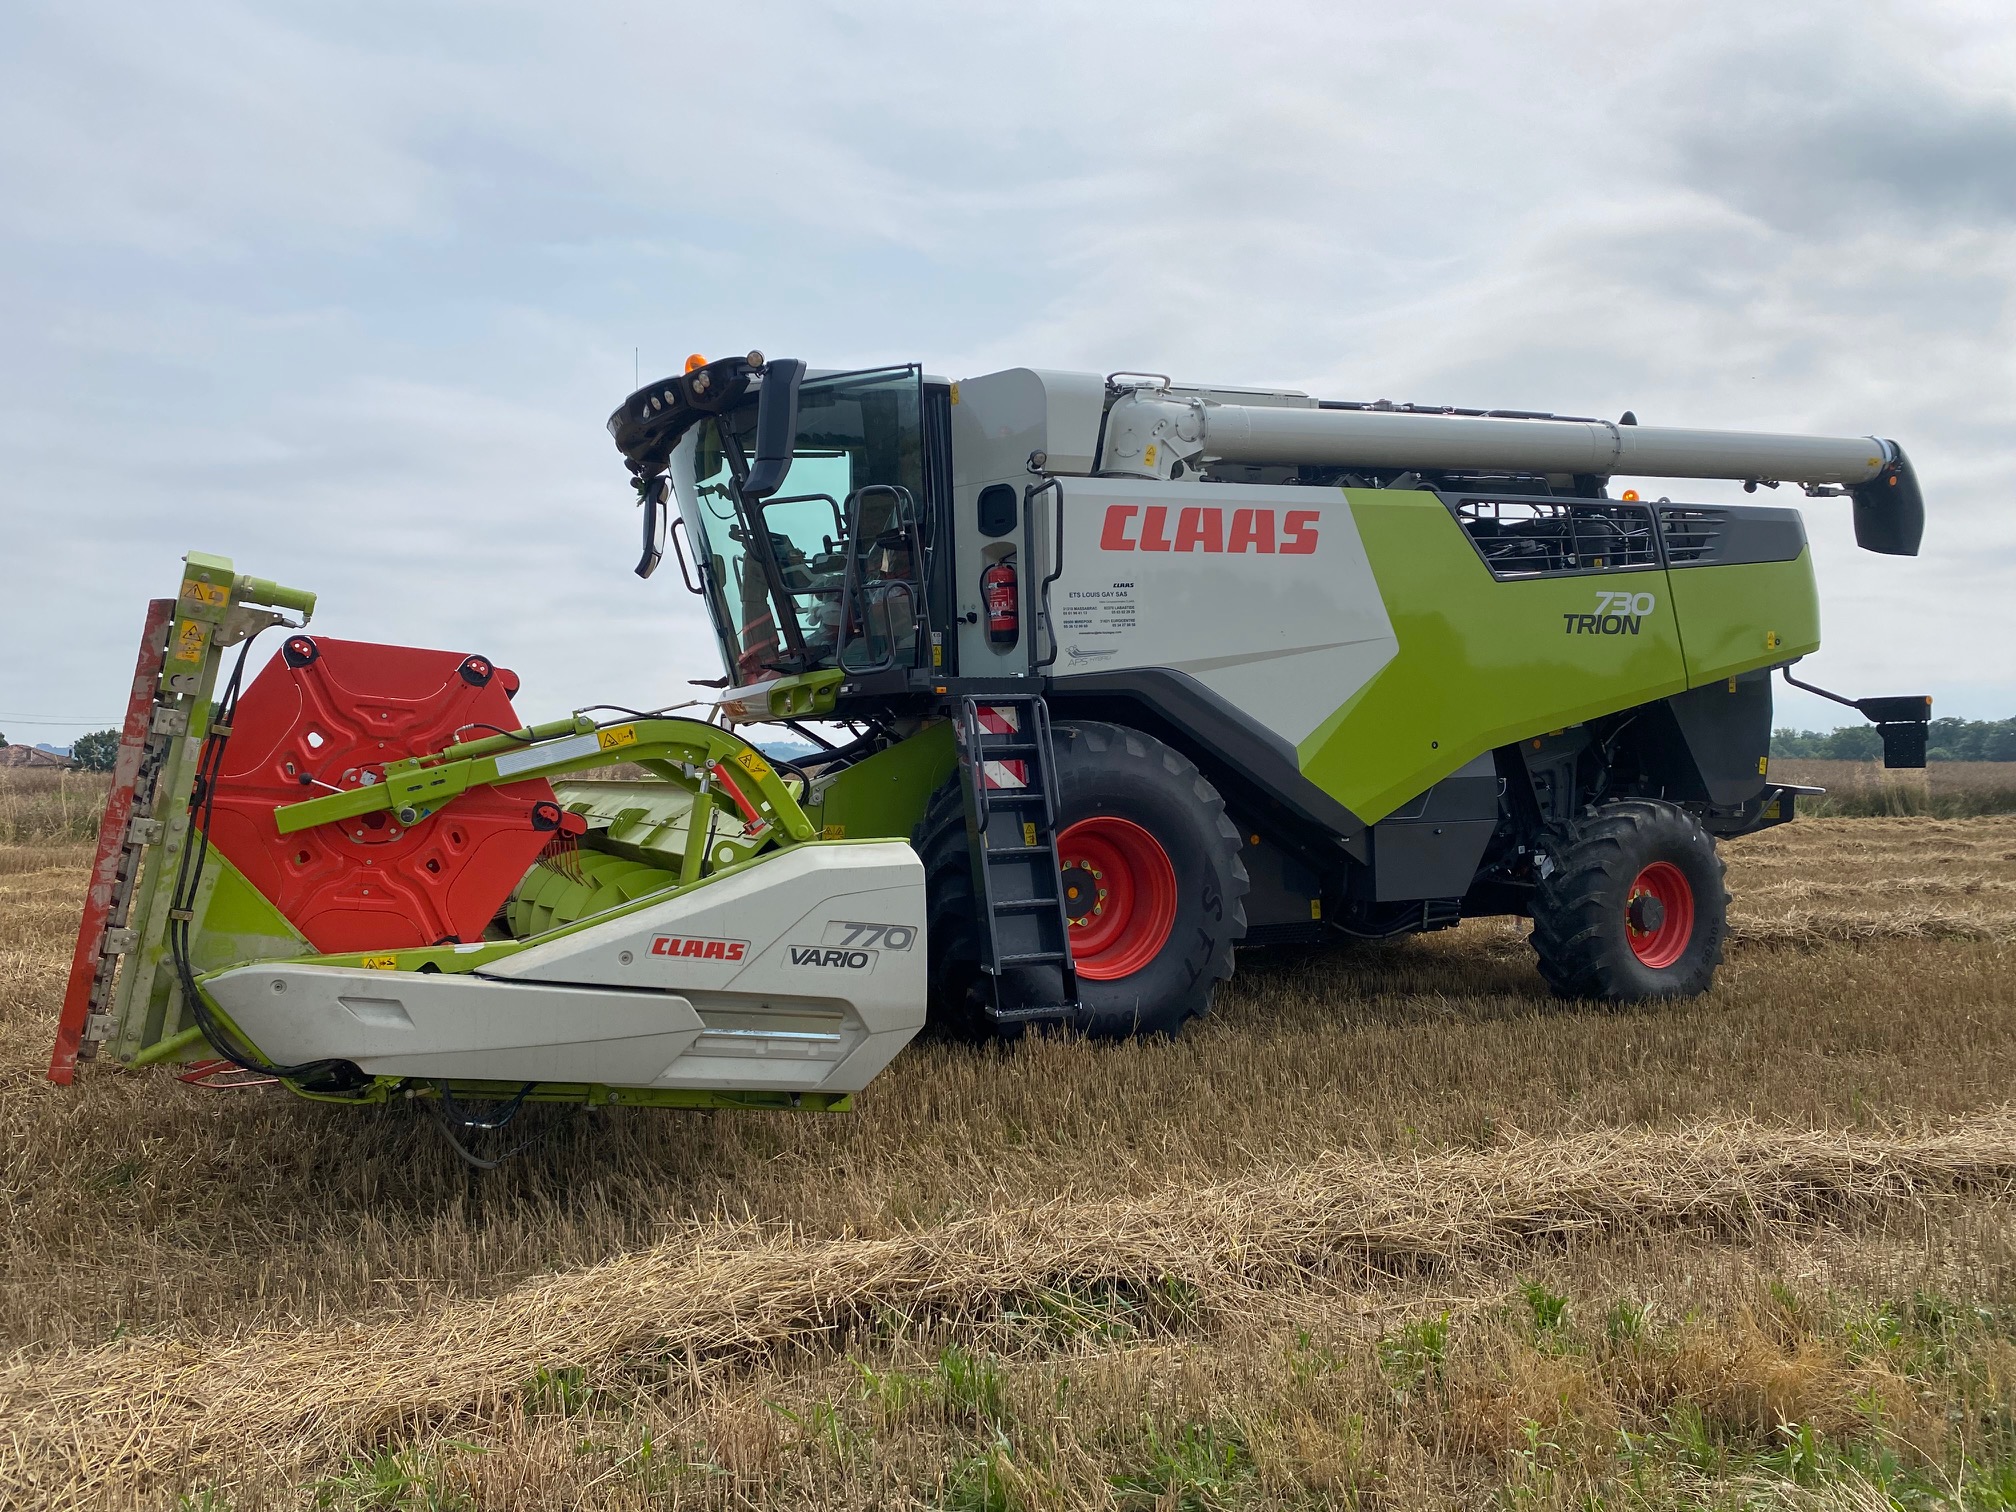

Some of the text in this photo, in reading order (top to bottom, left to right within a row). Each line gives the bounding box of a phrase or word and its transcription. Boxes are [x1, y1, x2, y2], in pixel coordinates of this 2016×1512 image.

[1100, 505, 1320, 554] CLAAS
[1593, 591, 1655, 616] 730
[1563, 614, 1641, 635] TRION
[1067, 657, 1088, 667] APS
[840, 923, 912, 949] 770
[651, 937, 745, 961] CLAAS
[790, 948, 868, 969] VARIO
